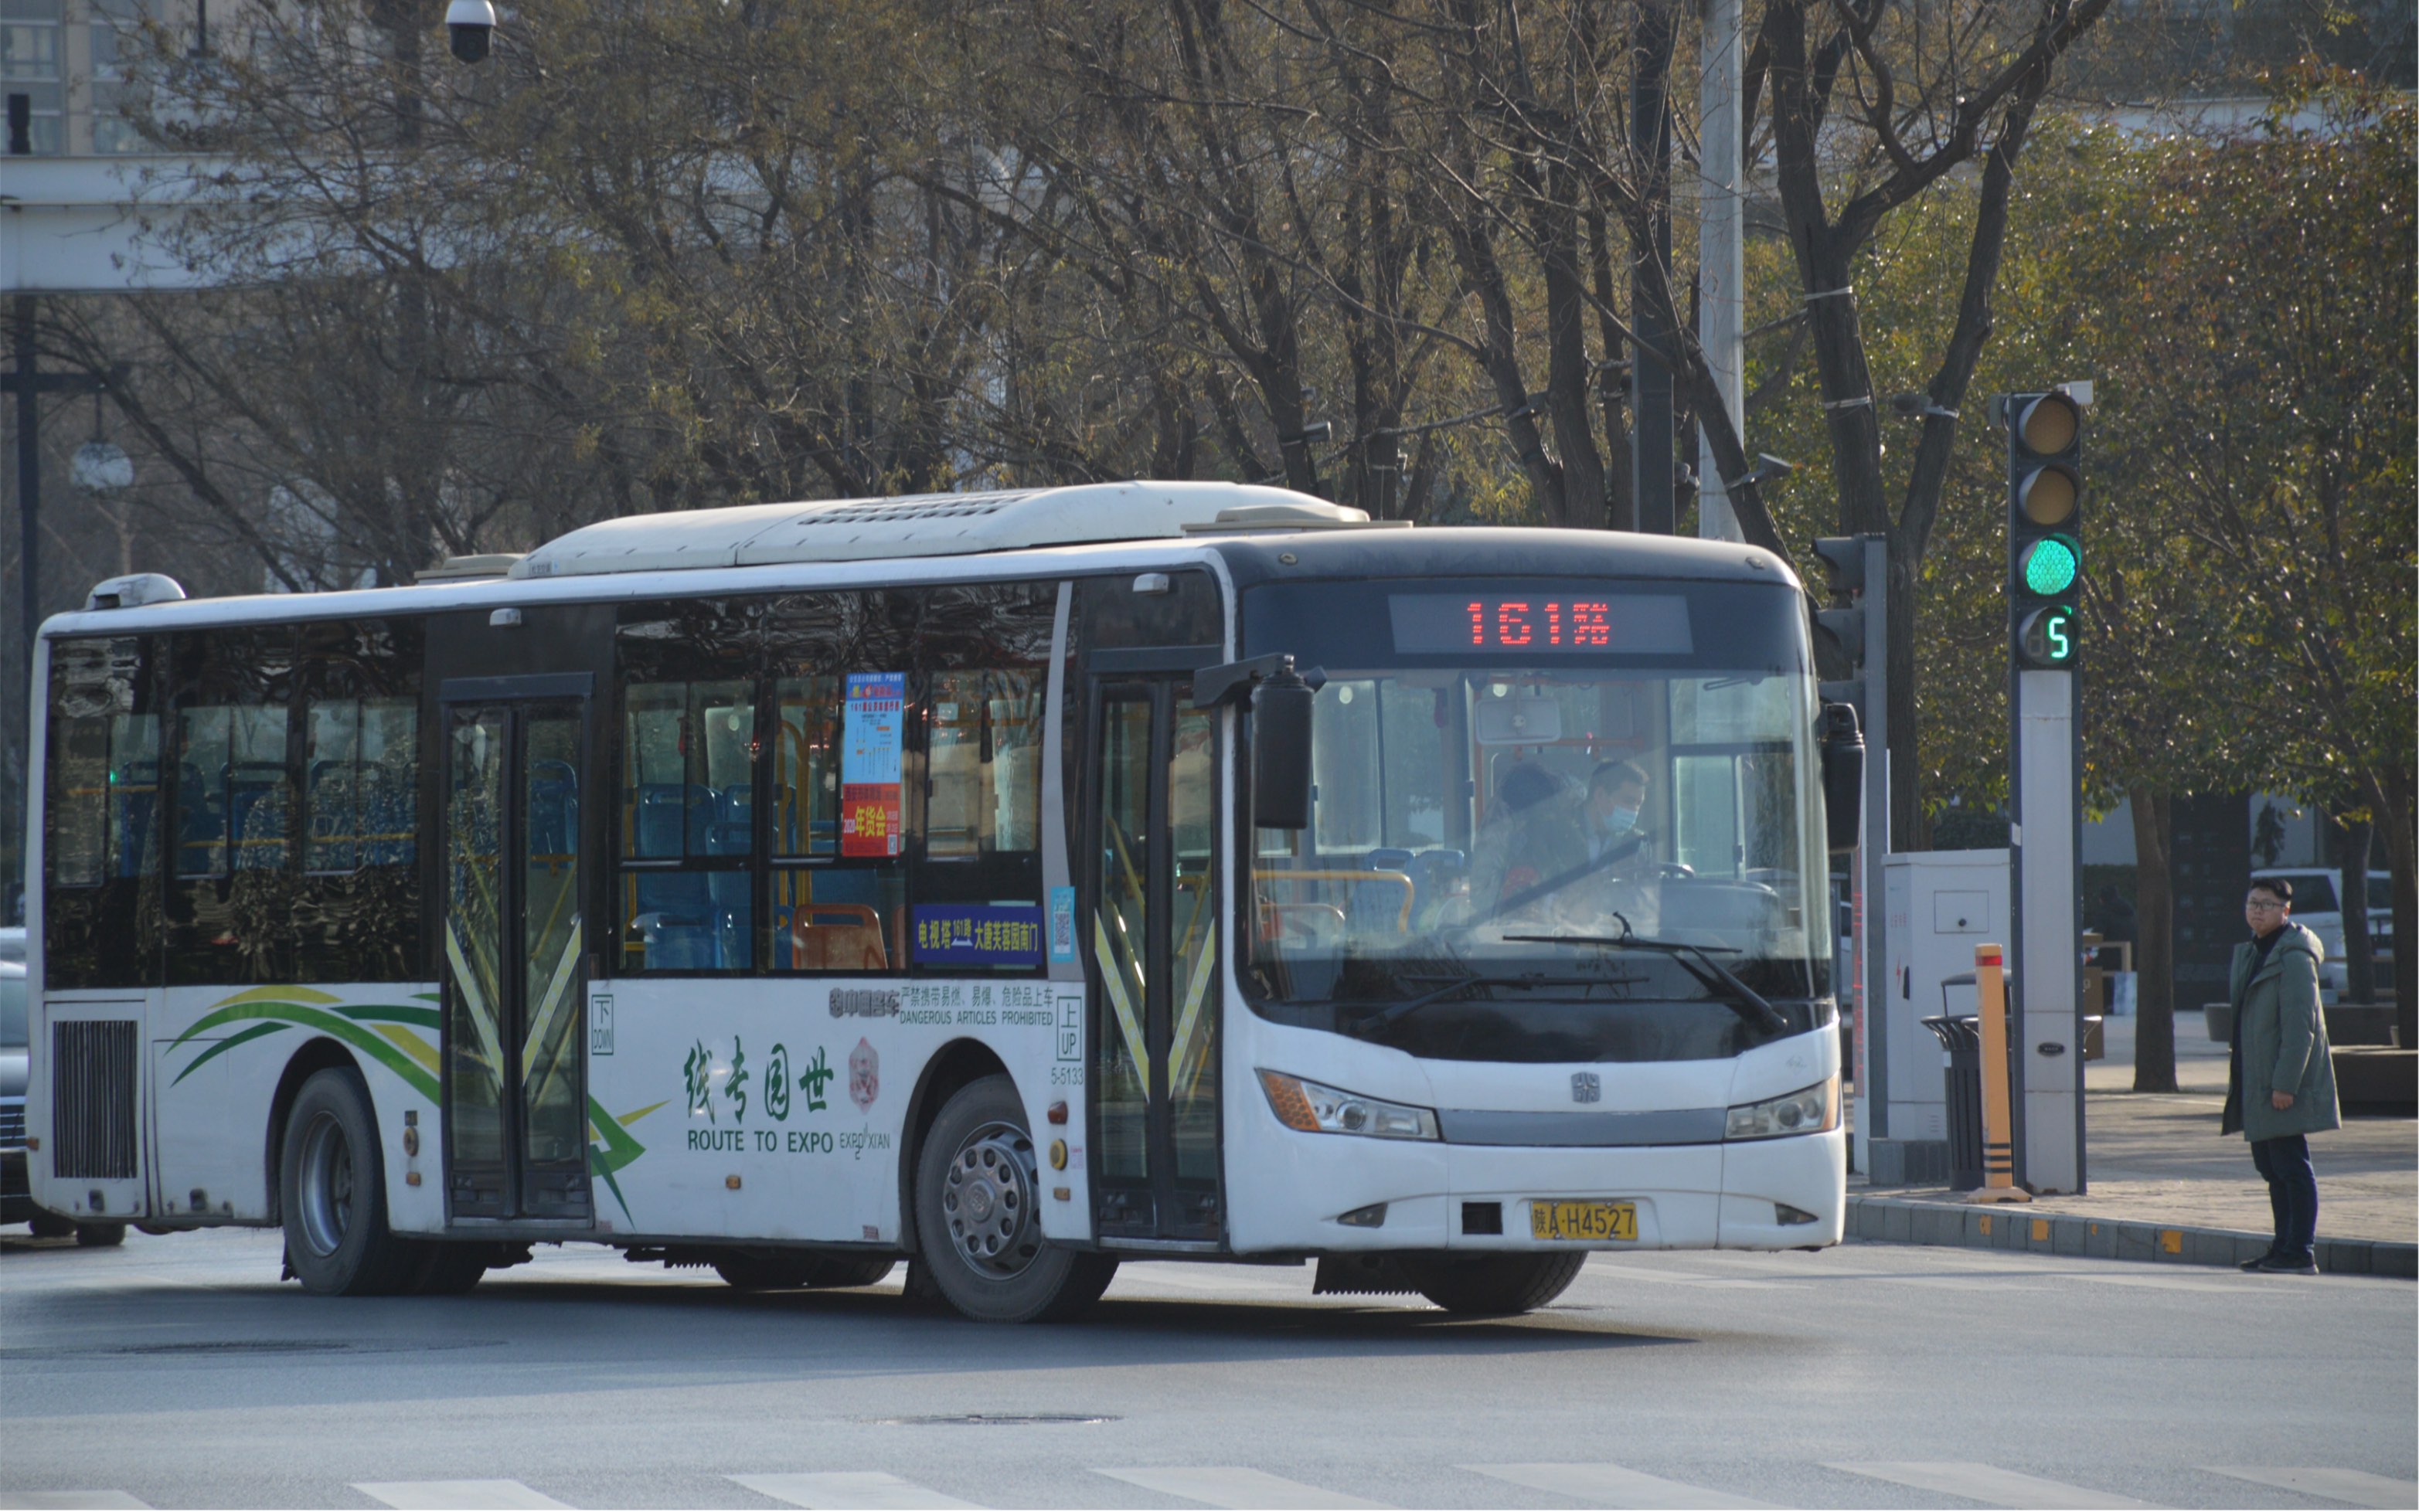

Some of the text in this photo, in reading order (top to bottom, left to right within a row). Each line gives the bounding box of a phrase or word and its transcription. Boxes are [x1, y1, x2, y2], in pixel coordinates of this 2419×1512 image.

[1468, 603, 1610, 644] 161路
[2049, 617, 2068, 658] 5
[856, 806, 886, 838] 年货会
[918, 917, 1039, 952] 电视塔 161路 大唐芙蓉园南门
[594, 1000, 611, 1024] 下
[900, 1011, 1053, 1025] DANGEROUS ARTICLES PROHIBITED
[1061, 1002, 1078, 1028] 上
[594, 1028, 612, 1049] DOWN
[1062, 1033, 1077, 1055] UP
[1051, 1067, 1084, 1085] 5-5133
[688, 1130, 833, 1154] ROUTE TO EXPO
